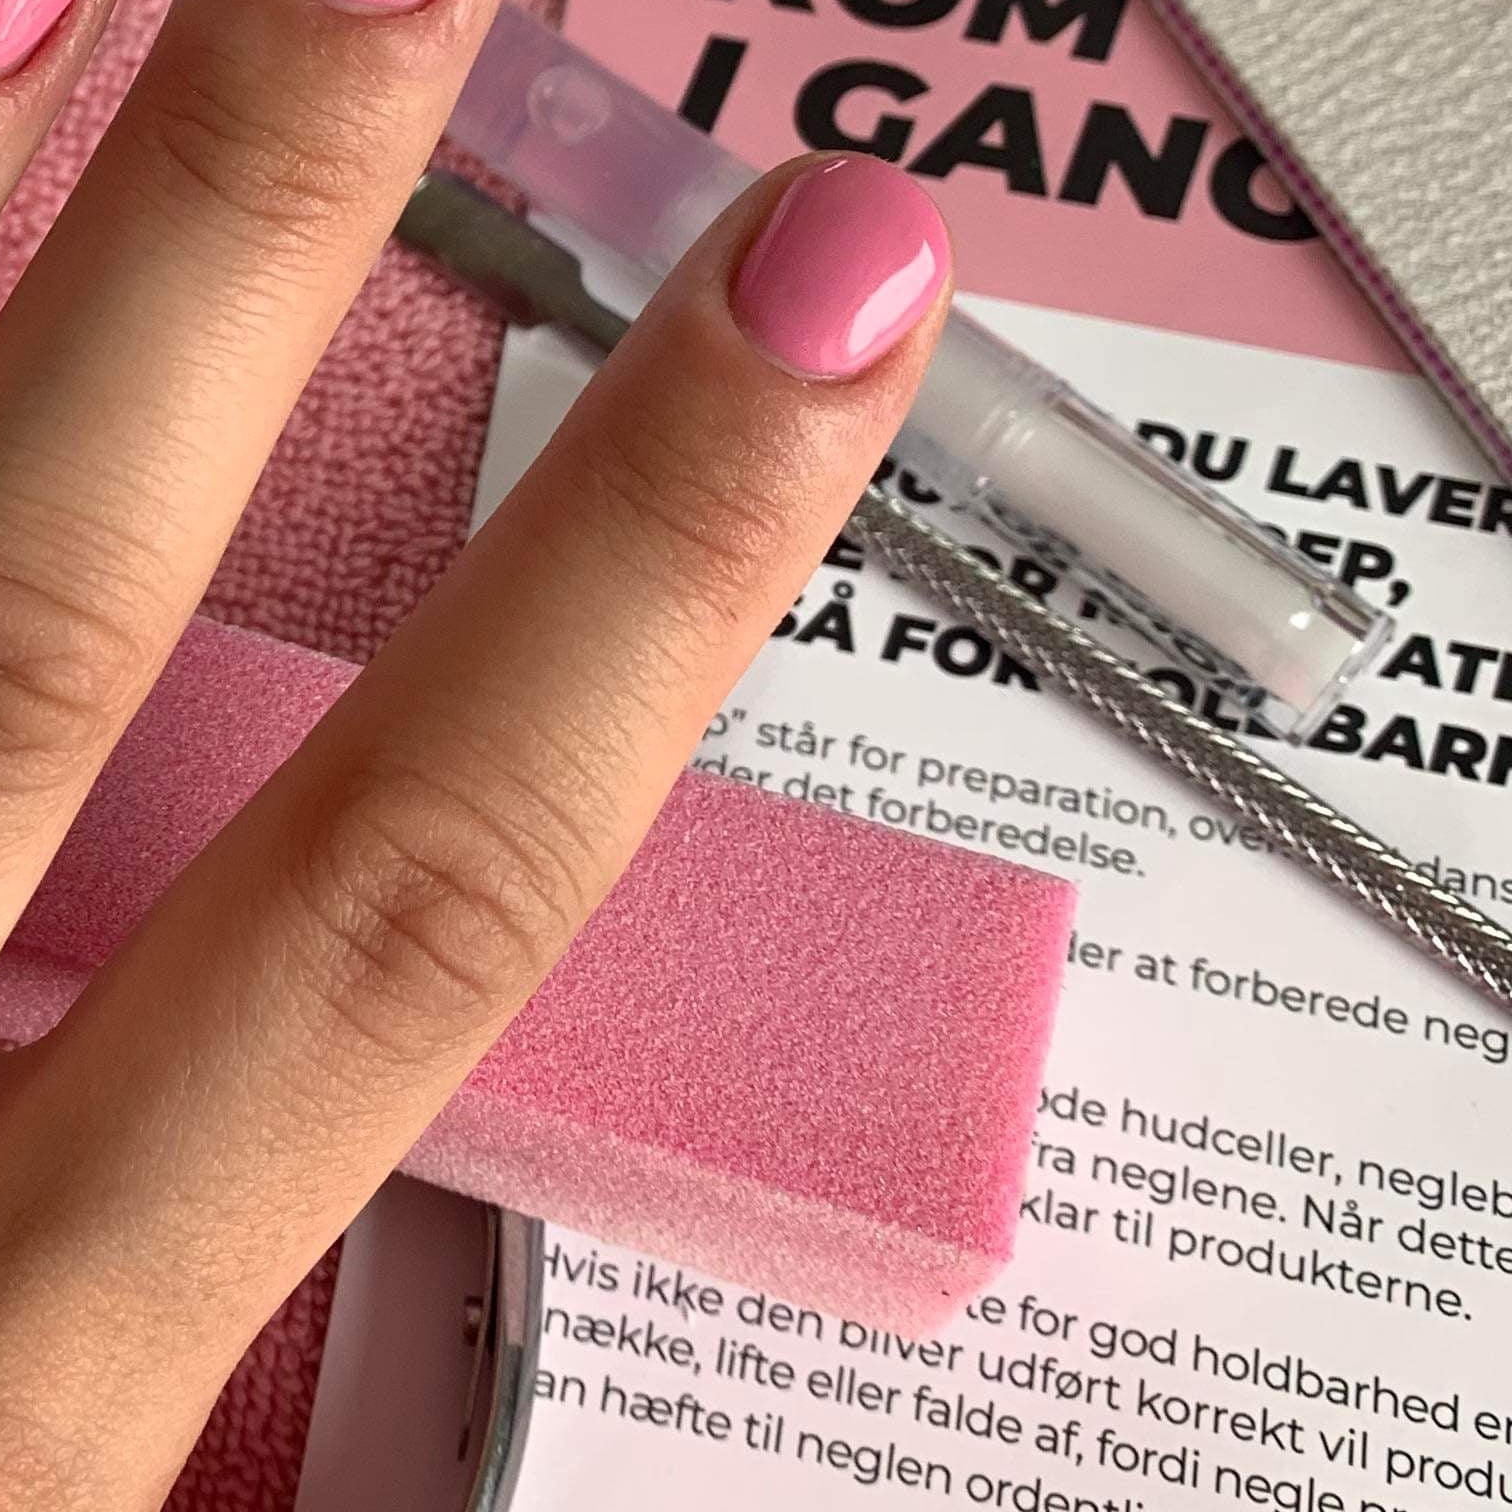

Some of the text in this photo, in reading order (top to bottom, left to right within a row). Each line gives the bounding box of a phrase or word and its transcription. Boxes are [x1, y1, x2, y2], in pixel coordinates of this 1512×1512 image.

[676, 33, 749, 136] I
[1260, 523, 1413, 609] EP,
[755, 718, 838, 761] står
[848, 732, 907, 775] for
[916, 756, 1178, 840] preparation,
[783, 770, 856, 815] det
[866, 786, 1146, 877] forberedelse.
[1134, 954, 1178, 988] at
[1191, 957, 1410, 1036] forberede
[1425, 1014, 1511, 1065] neg
[1030, 1130, 1512, 1275] ra neglene. Når dette
[1121, 1097, 1343, 1187] hudceller,
[1357, 1157, 1512, 1220] negleb
[1018, 1187, 1473, 1322] klar til produkterne.
[544, 1242, 620, 1293] Hvis
[632, 1260, 725, 1316] ikke
[736, 1292, 824, 1340] den
[977, 1352, 1121, 1411] udført
[1136, 1378, 1306, 1455] korrekt
[1318, 1427, 1370, 1471] vil
[1017, 1294, 1080, 1341] for
[1088, 1320, 1178, 1367] god
[1191, 1333, 1461, 1433] holdbarhed
[600, 1374, 733, 1441] hæfte
[743, 1411, 785, 1455] til
[796, 1431, 953, 1497] neglen
[714, 1336, 796, 1390] lifte
[806, 1364, 902, 1416] eller
[912, 1384, 1024, 1445] falde
[1034, 1419, 1084, 1468] af,
[1095, 1428, 1201, 1488] fordi
[1214, 1461, 1346, 1512] negle
